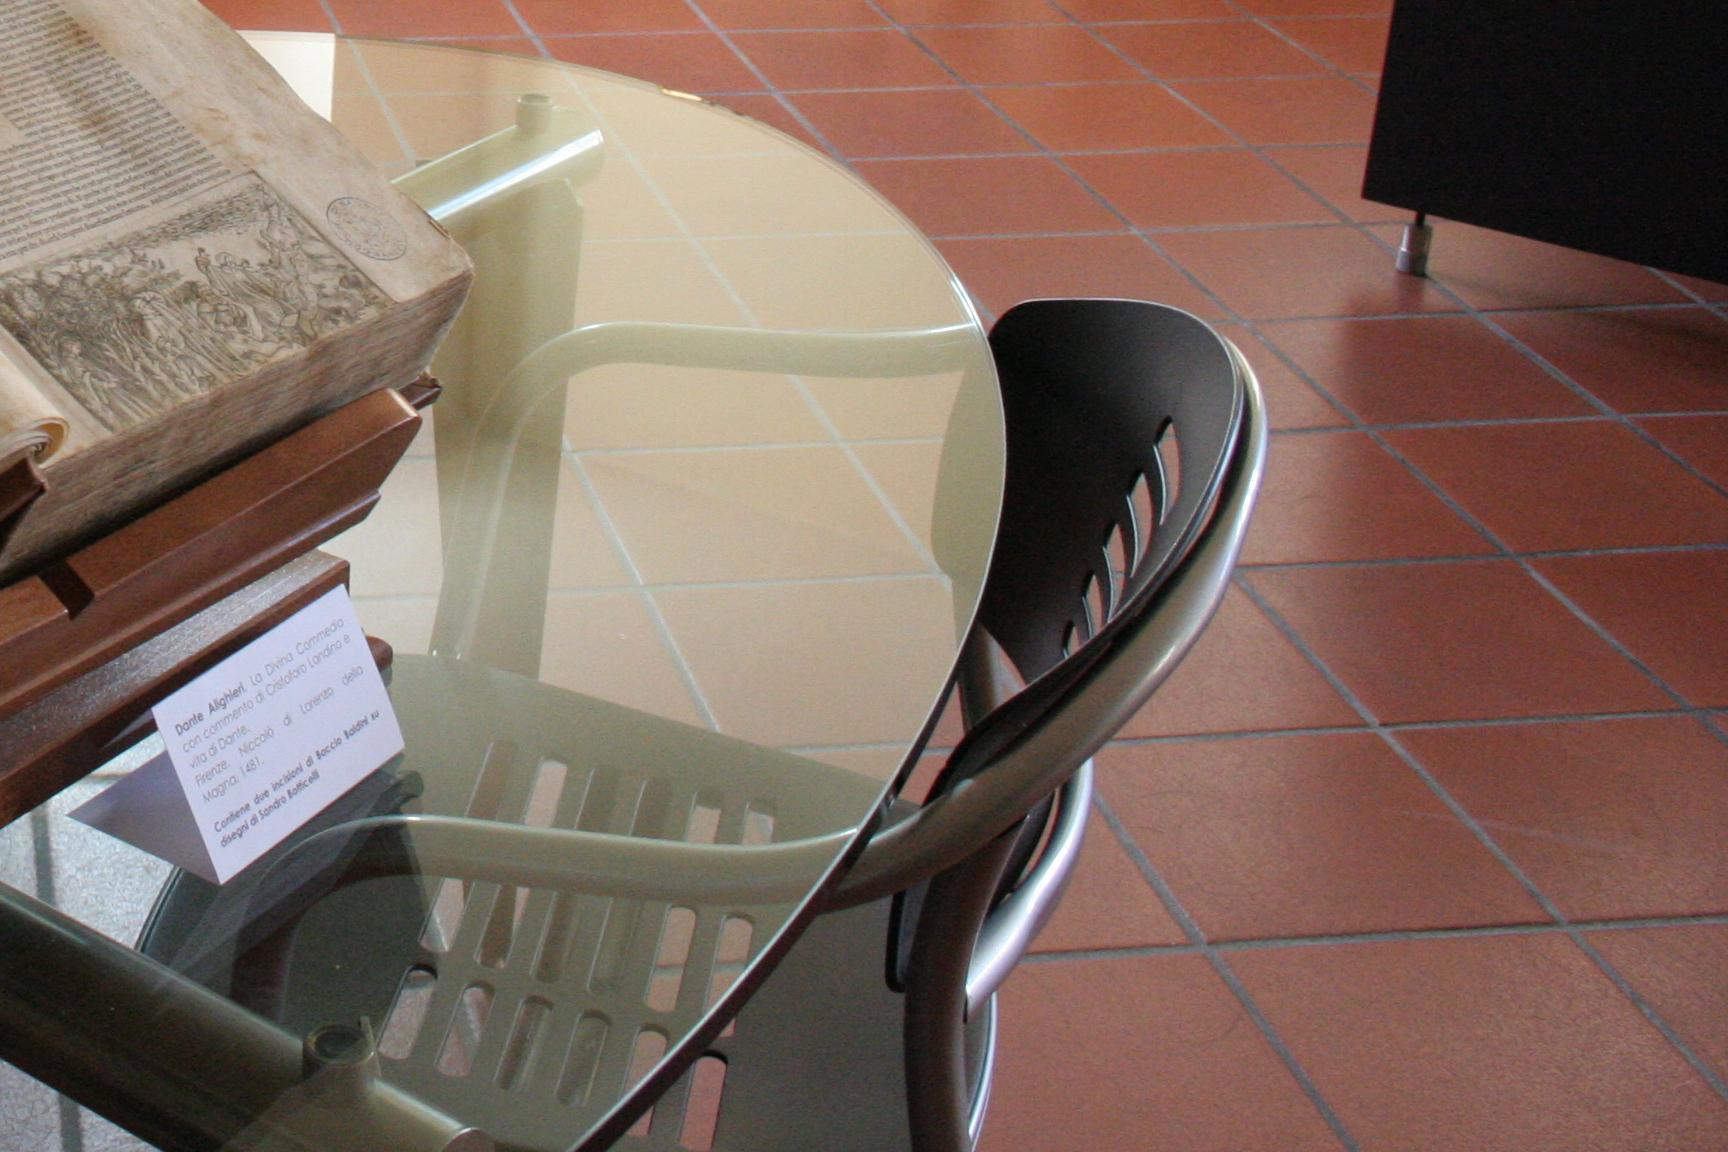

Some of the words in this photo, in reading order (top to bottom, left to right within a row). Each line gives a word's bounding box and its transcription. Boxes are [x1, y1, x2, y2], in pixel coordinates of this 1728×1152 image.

[175, 712, 204, 736] Dante
[249, 672, 263, 686] La
[264, 651, 293, 676] Divina
[295, 618, 344, 655] Commedia
[182, 734, 202, 752] con
[203, 698, 253, 739] commento
[255, 690, 265, 704] di
[265, 663, 307, 696] Cristoforo
[306, 639, 342, 668] Landino
[344, 633, 351, 644] e
[238, 726, 274, 757] Niccolò
[283, 712, 292, 727] di
[299, 686, 334, 714] Lorenzo
[342, 665, 364, 686] della
[190, 751, 207, 769] vita
[208, 742, 218, 757] di
[214, 802, 251, 833] Contiene
[254, 789, 270, 805] due
[271, 762, 304, 792] incisioni
[305, 755, 314, 768] di
[315, 736, 342, 760] Baccio
[344, 715, 369, 740] Baldini
[371, 709, 380, 721] su
[220, 821, 250, 848] disegni
[250, 812, 259, 827] di
[258, 795, 287, 821] Sandro
[286, 768, 320, 800] Botticelli
